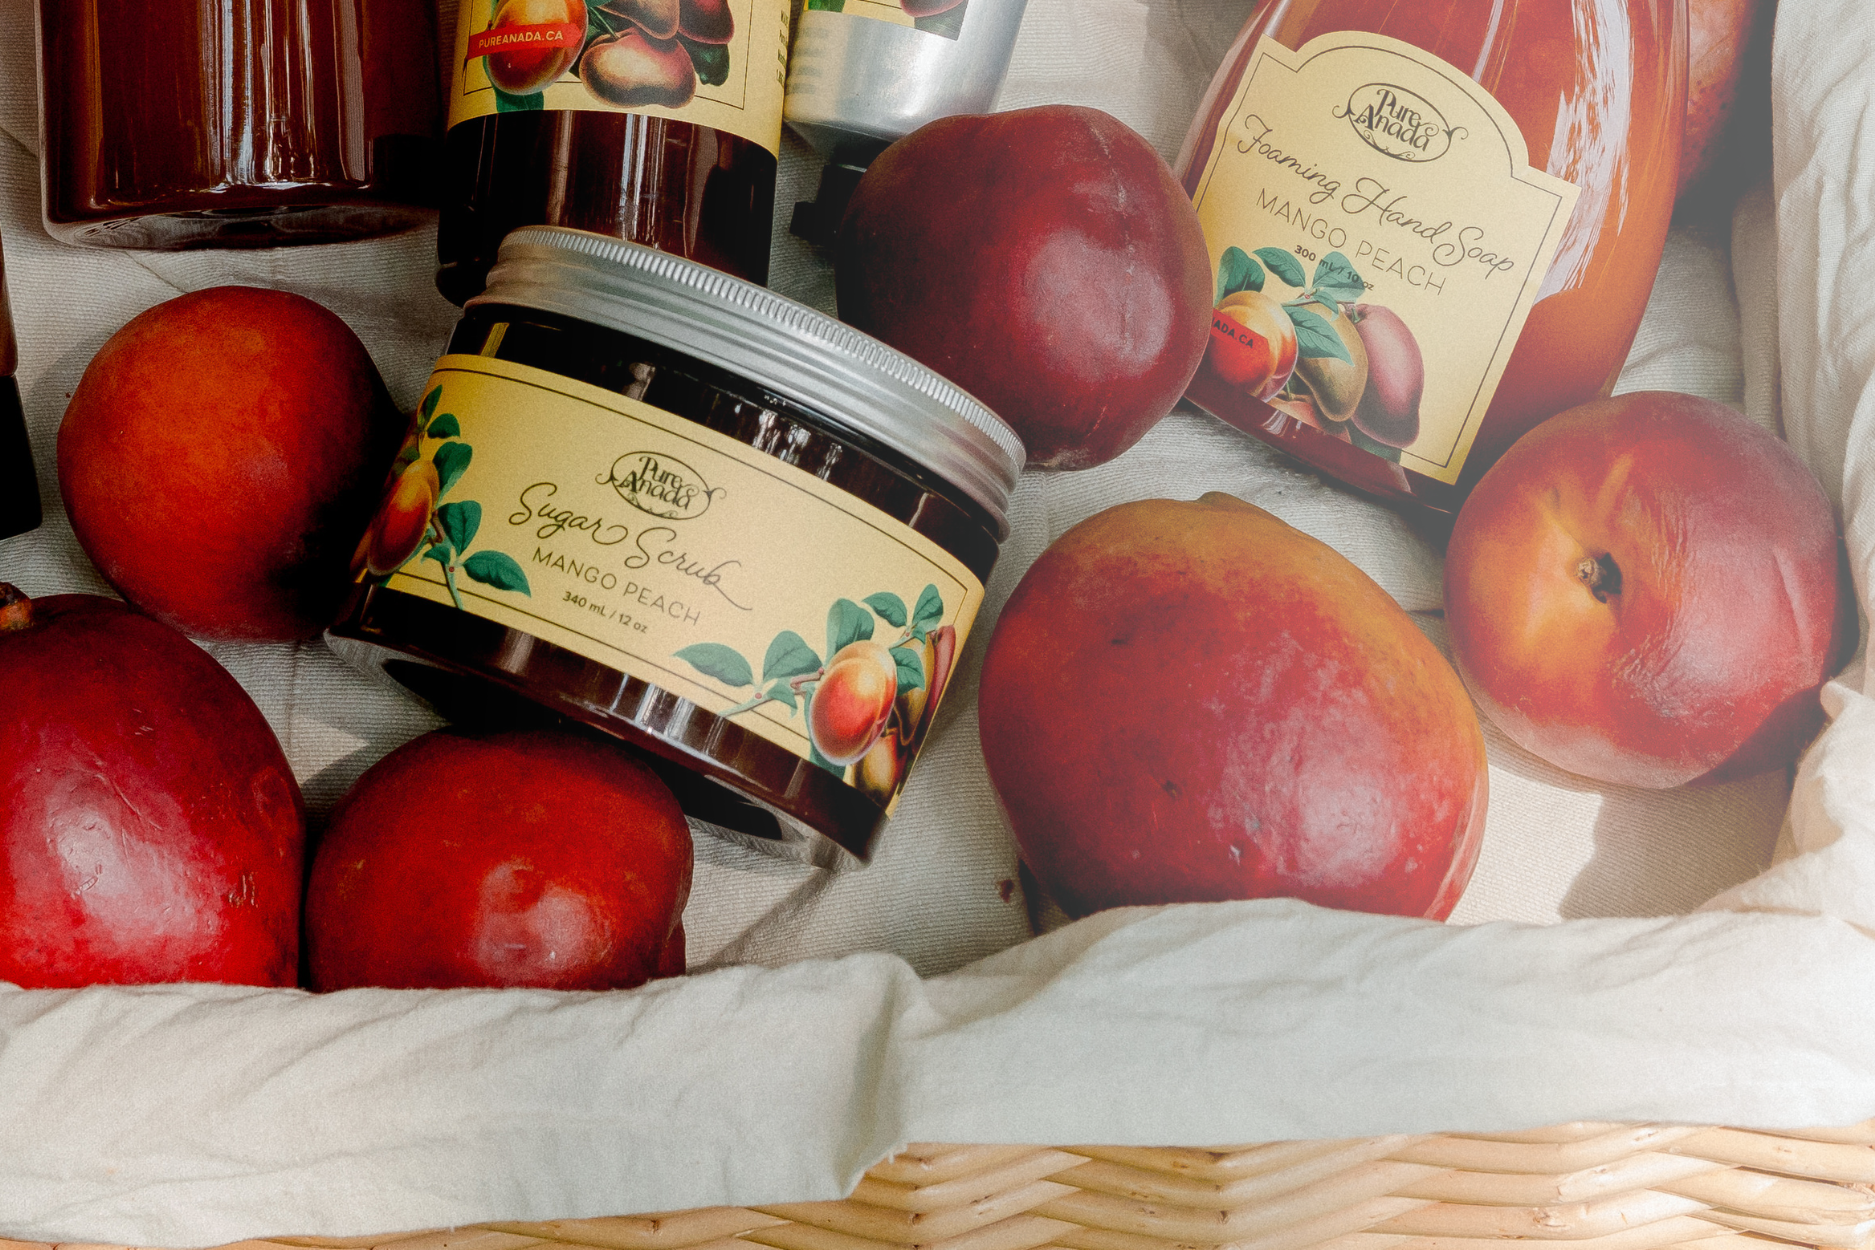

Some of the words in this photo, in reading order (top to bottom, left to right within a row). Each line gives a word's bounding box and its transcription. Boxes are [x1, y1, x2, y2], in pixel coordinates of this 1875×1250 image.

[478, 30, 564, 49] PUREANADA.CA
[1356, 103, 1430, 152] Anada
[1374, 88, 1422, 126] Pure
[1237, 114, 1341, 204] Foaming
[1341, 177, 1452, 244] Hand
[1432, 226, 1515, 280] Soap
[1256, 188, 1347, 249] MANGO
[1356, 240, 1446, 295] PEACH
[1294, 244, 1317, 262] 300
[1319, 258, 1335, 272] mL
[1346, 271, 1359, 283] 10
[1362, 281, 1374, 291] oz
[618, 472, 692, 512] Anada
[637, 455, 682, 488] Pure
[508, 482, 629, 546] Sugar
[624, 526, 753, 612] Scrub
[532, 546, 618, 592] MANGO
[623, 580, 702, 626] PEACH
[562, 590, 588, 608] 340
[588, 600, 608, 617] mL
[619, 613, 633, 627] 12
[633, 621, 648, 634] oz
